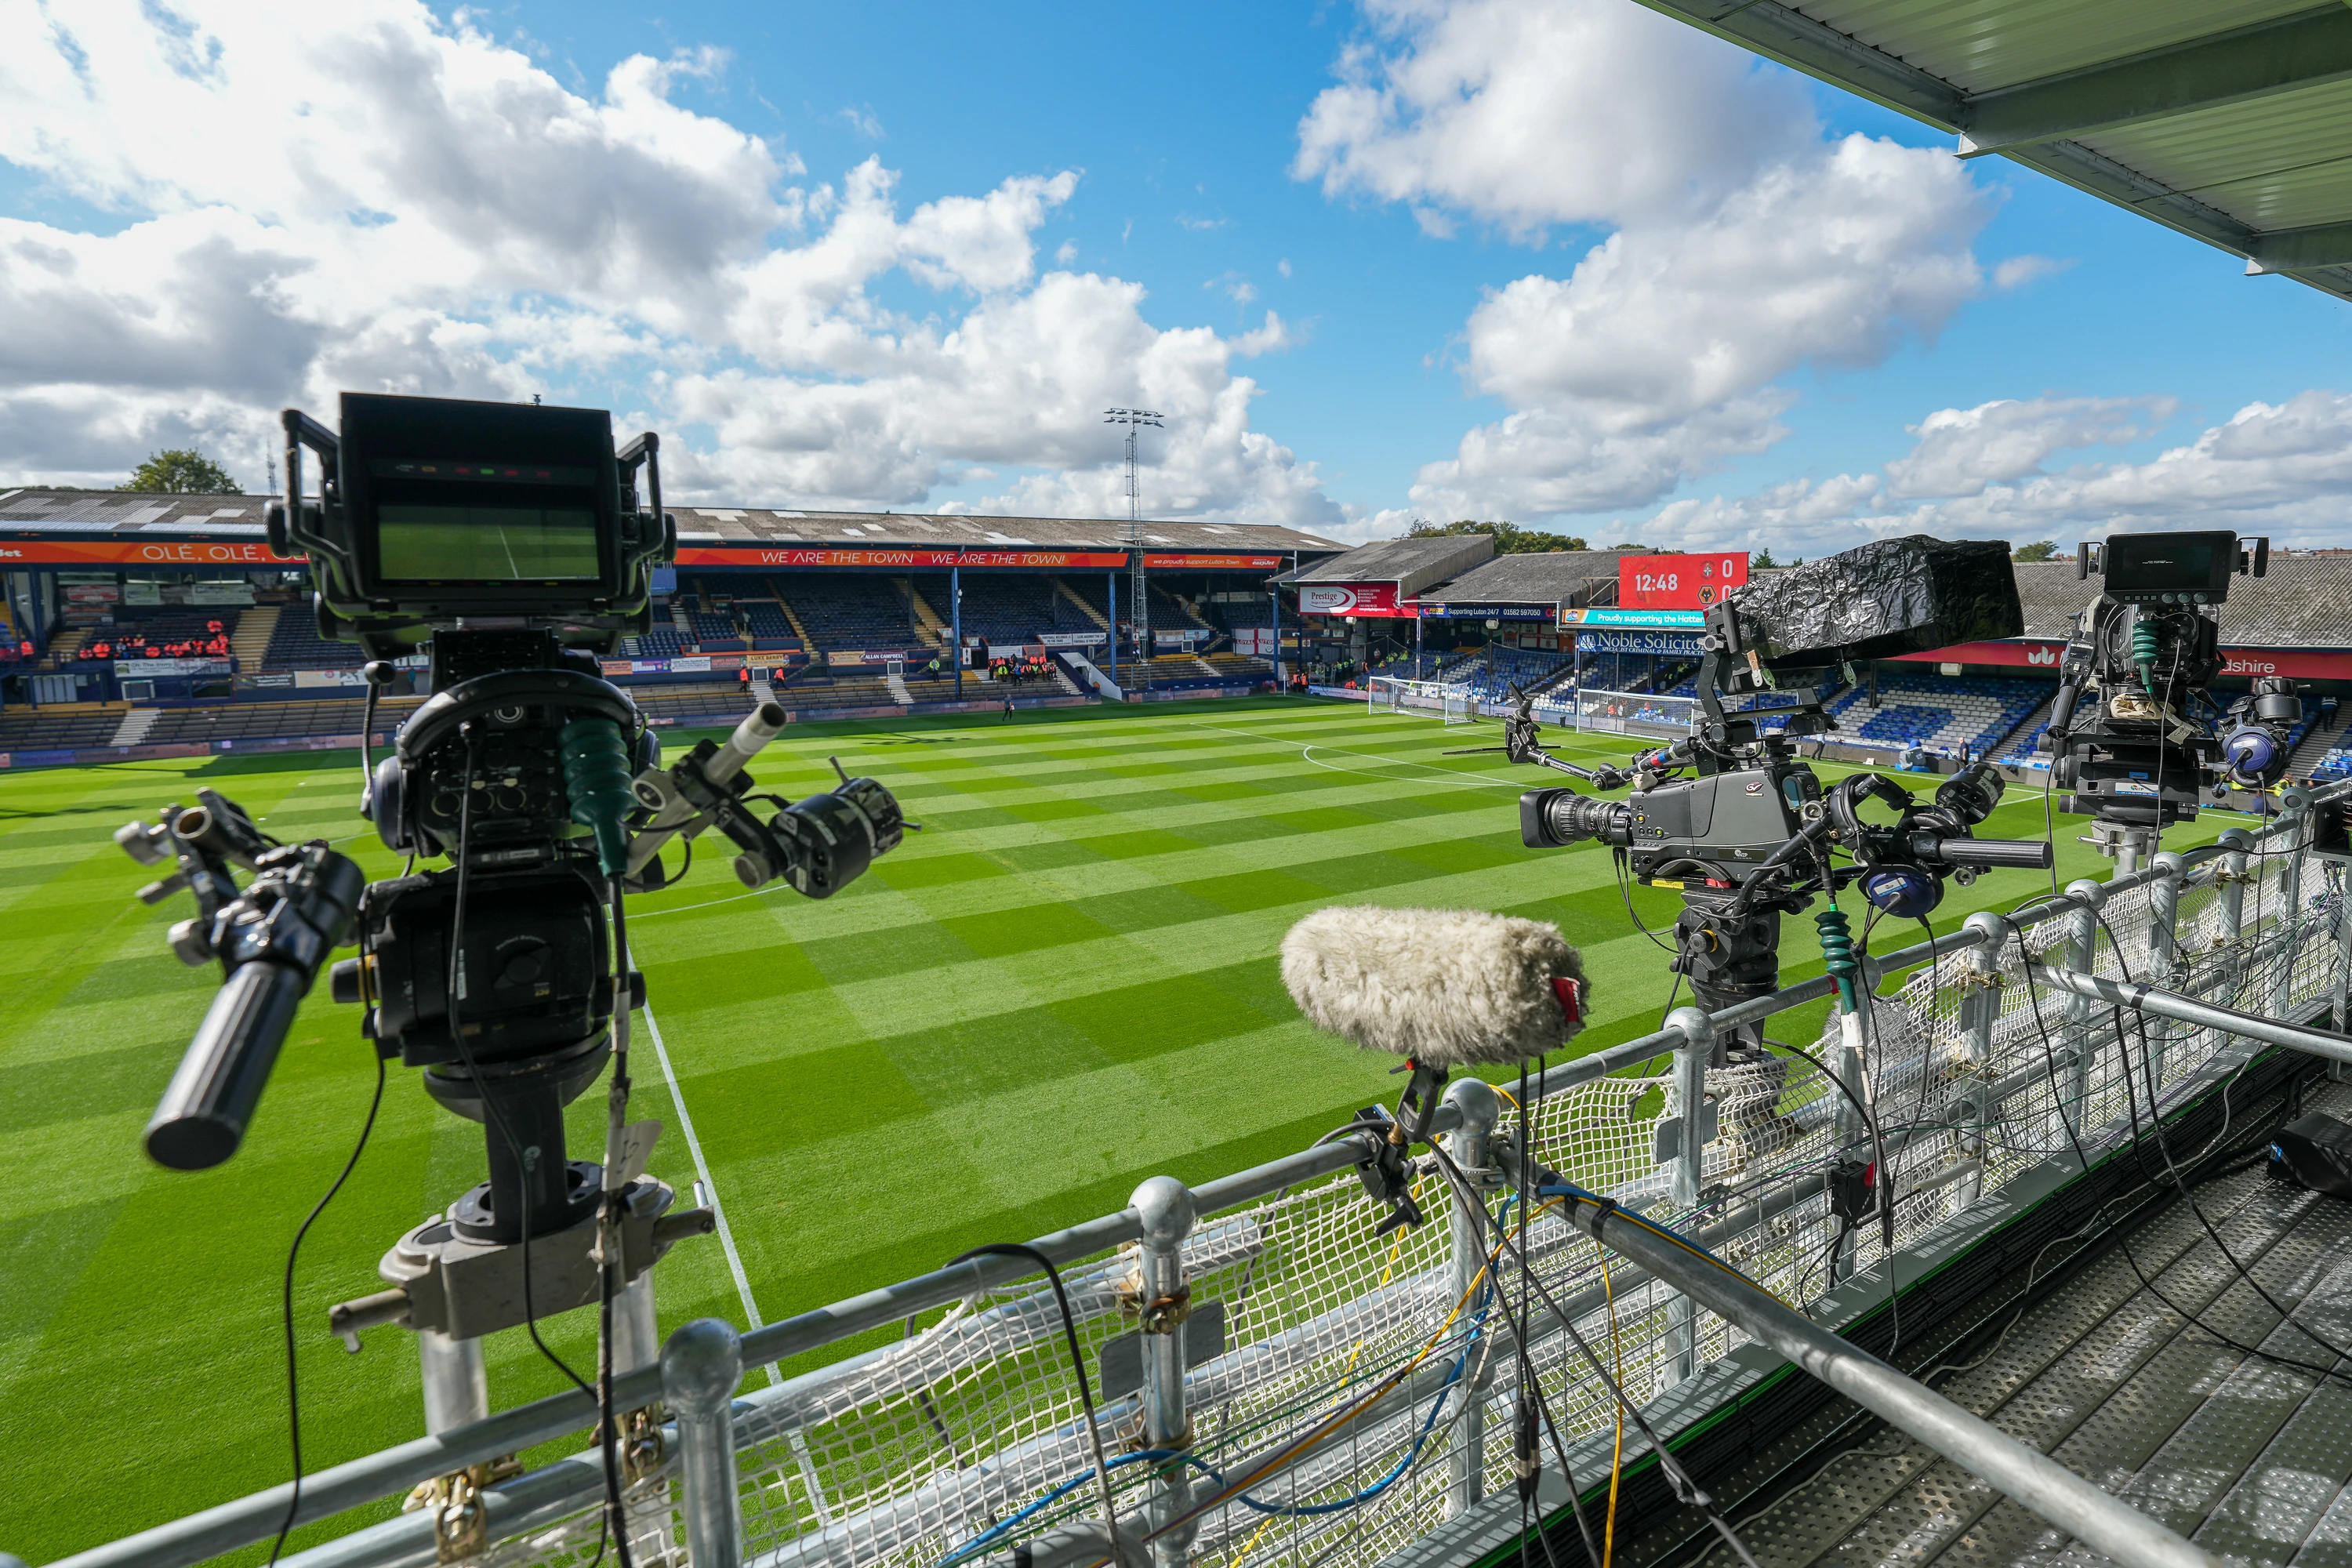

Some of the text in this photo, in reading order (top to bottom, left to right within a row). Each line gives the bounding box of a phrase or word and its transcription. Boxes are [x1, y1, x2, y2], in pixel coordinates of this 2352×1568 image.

[143, 544, 201, 562] OLÉ,
[209, 544, 266, 562] OLÉ,
[761, 551, 913, 564] WE ARE THE TOWN
[931, 554, 1065, 564] WE ARE THE TOWN!
[1722, 559, 1733, 578] 0
[1635, 573, 1678, 591] 12:48
[1311, 591, 1338, 601] Prestige
[1598, 613, 1623, 623] Proudly
[1624, 614, 1662, 624] supporting
[1664, 614, 1676, 622] the
[1597, 632, 1705, 650] Noble Solicito
